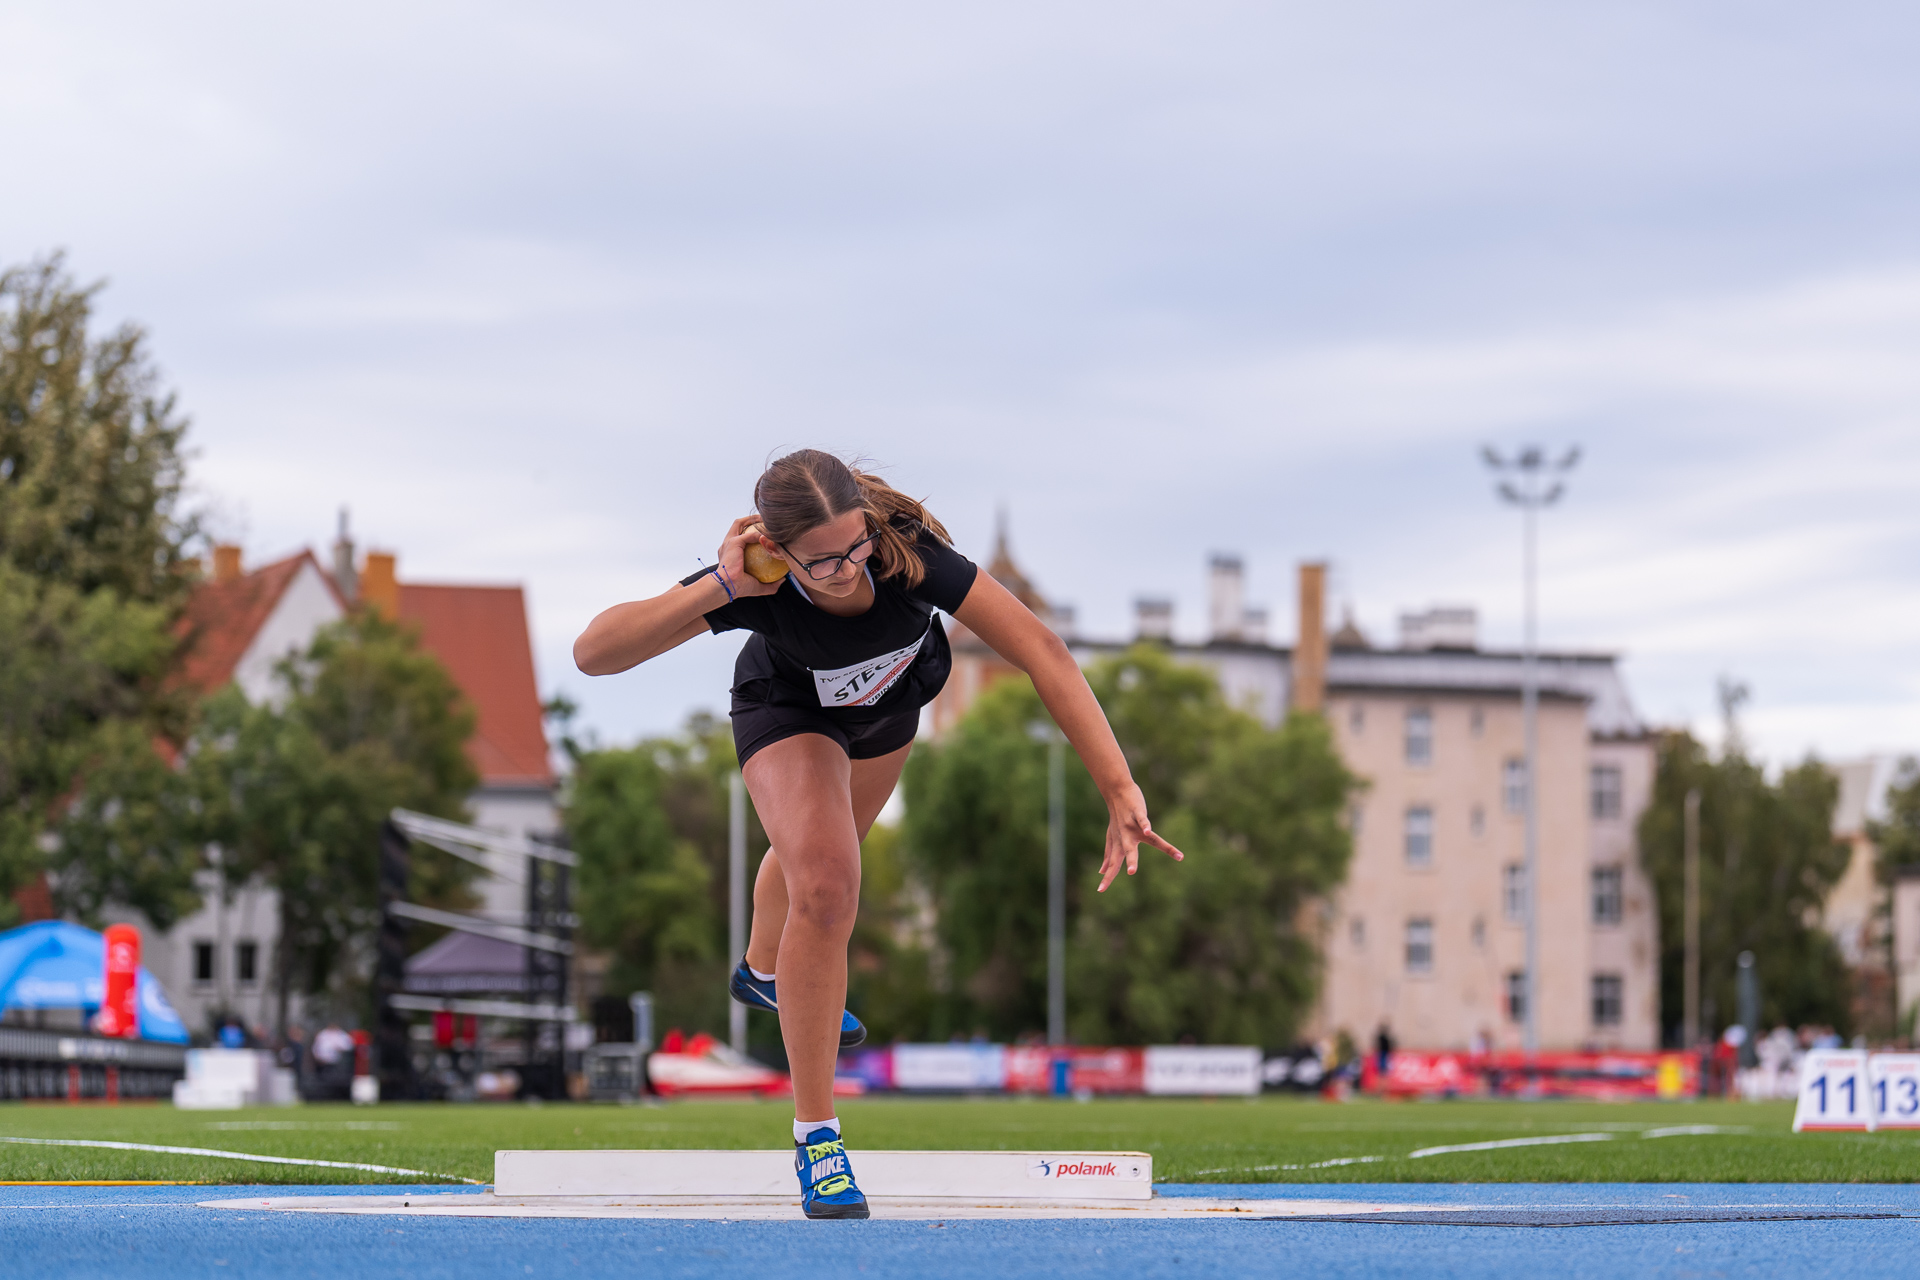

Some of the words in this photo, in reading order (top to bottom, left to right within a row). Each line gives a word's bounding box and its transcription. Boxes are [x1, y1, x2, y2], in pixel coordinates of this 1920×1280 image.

[1810, 1074, 1856, 1114] 11
[1874, 1077, 1920, 1115] 13
[811, 1155, 845, 1184] NIKE
[1056, 1161, 1117, 1178] polanik
